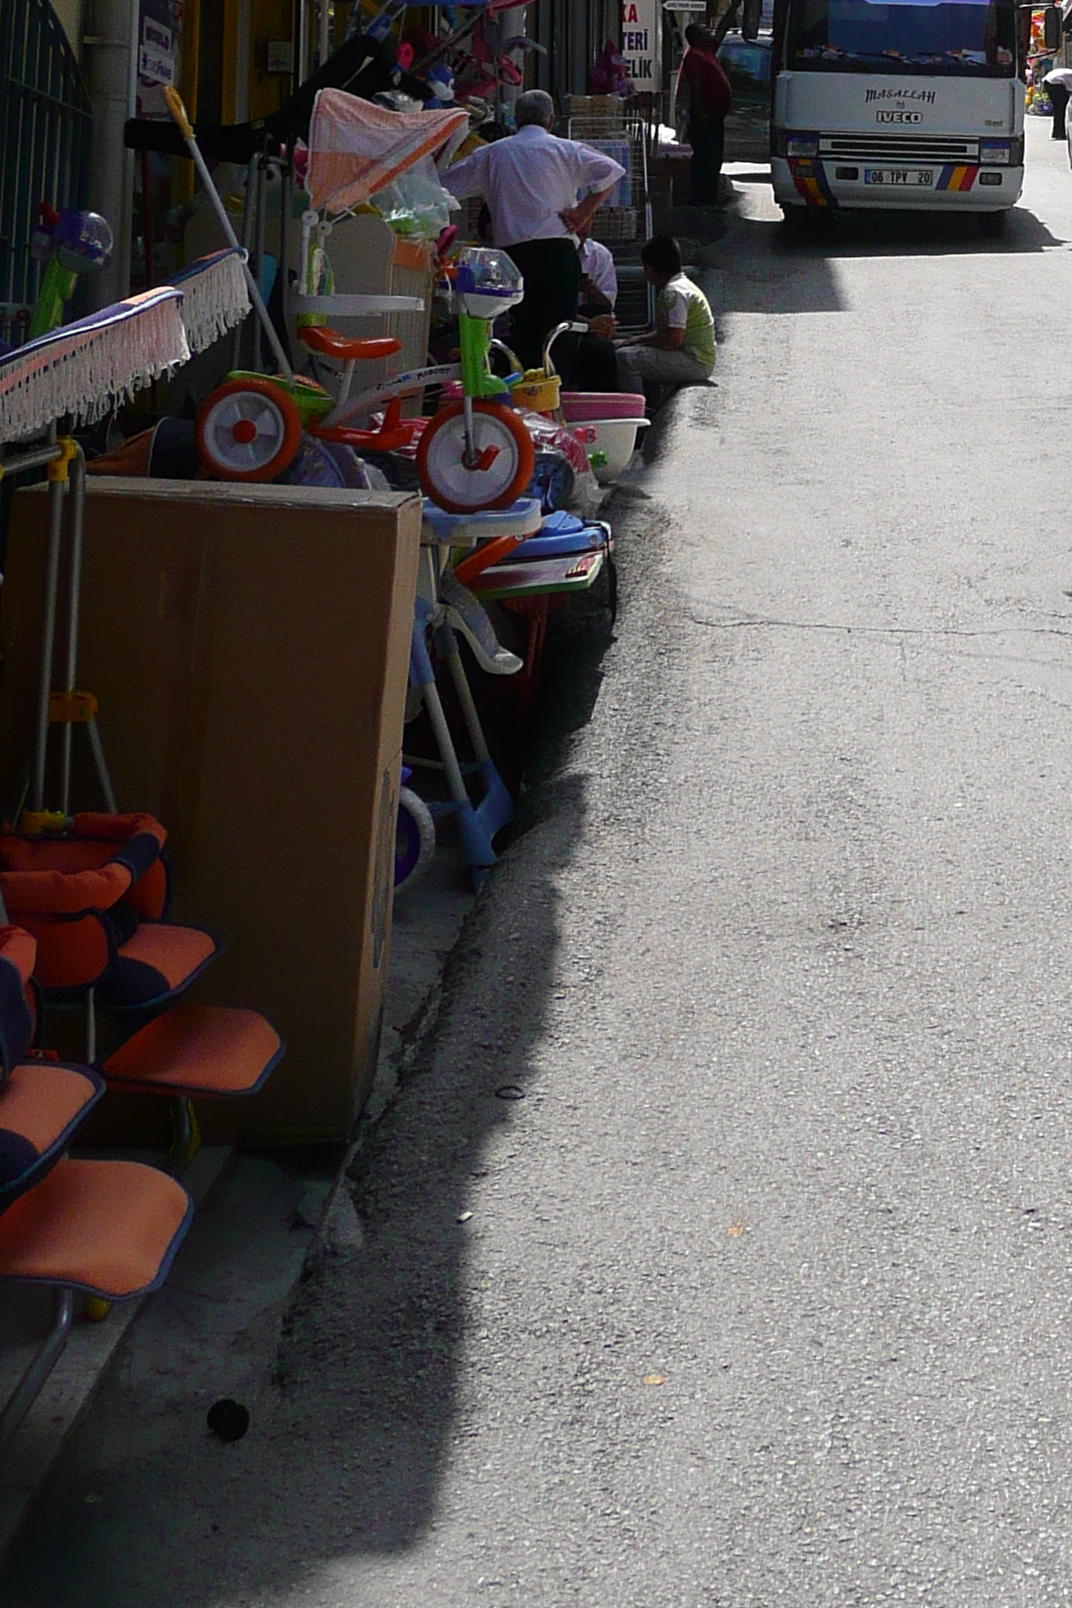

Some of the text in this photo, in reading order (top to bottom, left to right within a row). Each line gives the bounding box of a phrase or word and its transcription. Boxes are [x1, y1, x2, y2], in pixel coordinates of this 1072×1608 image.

[876, 110, 923, 124] IVECO
[872, 171, 883, 183] 06
[918, 172, 930, 183] 20
